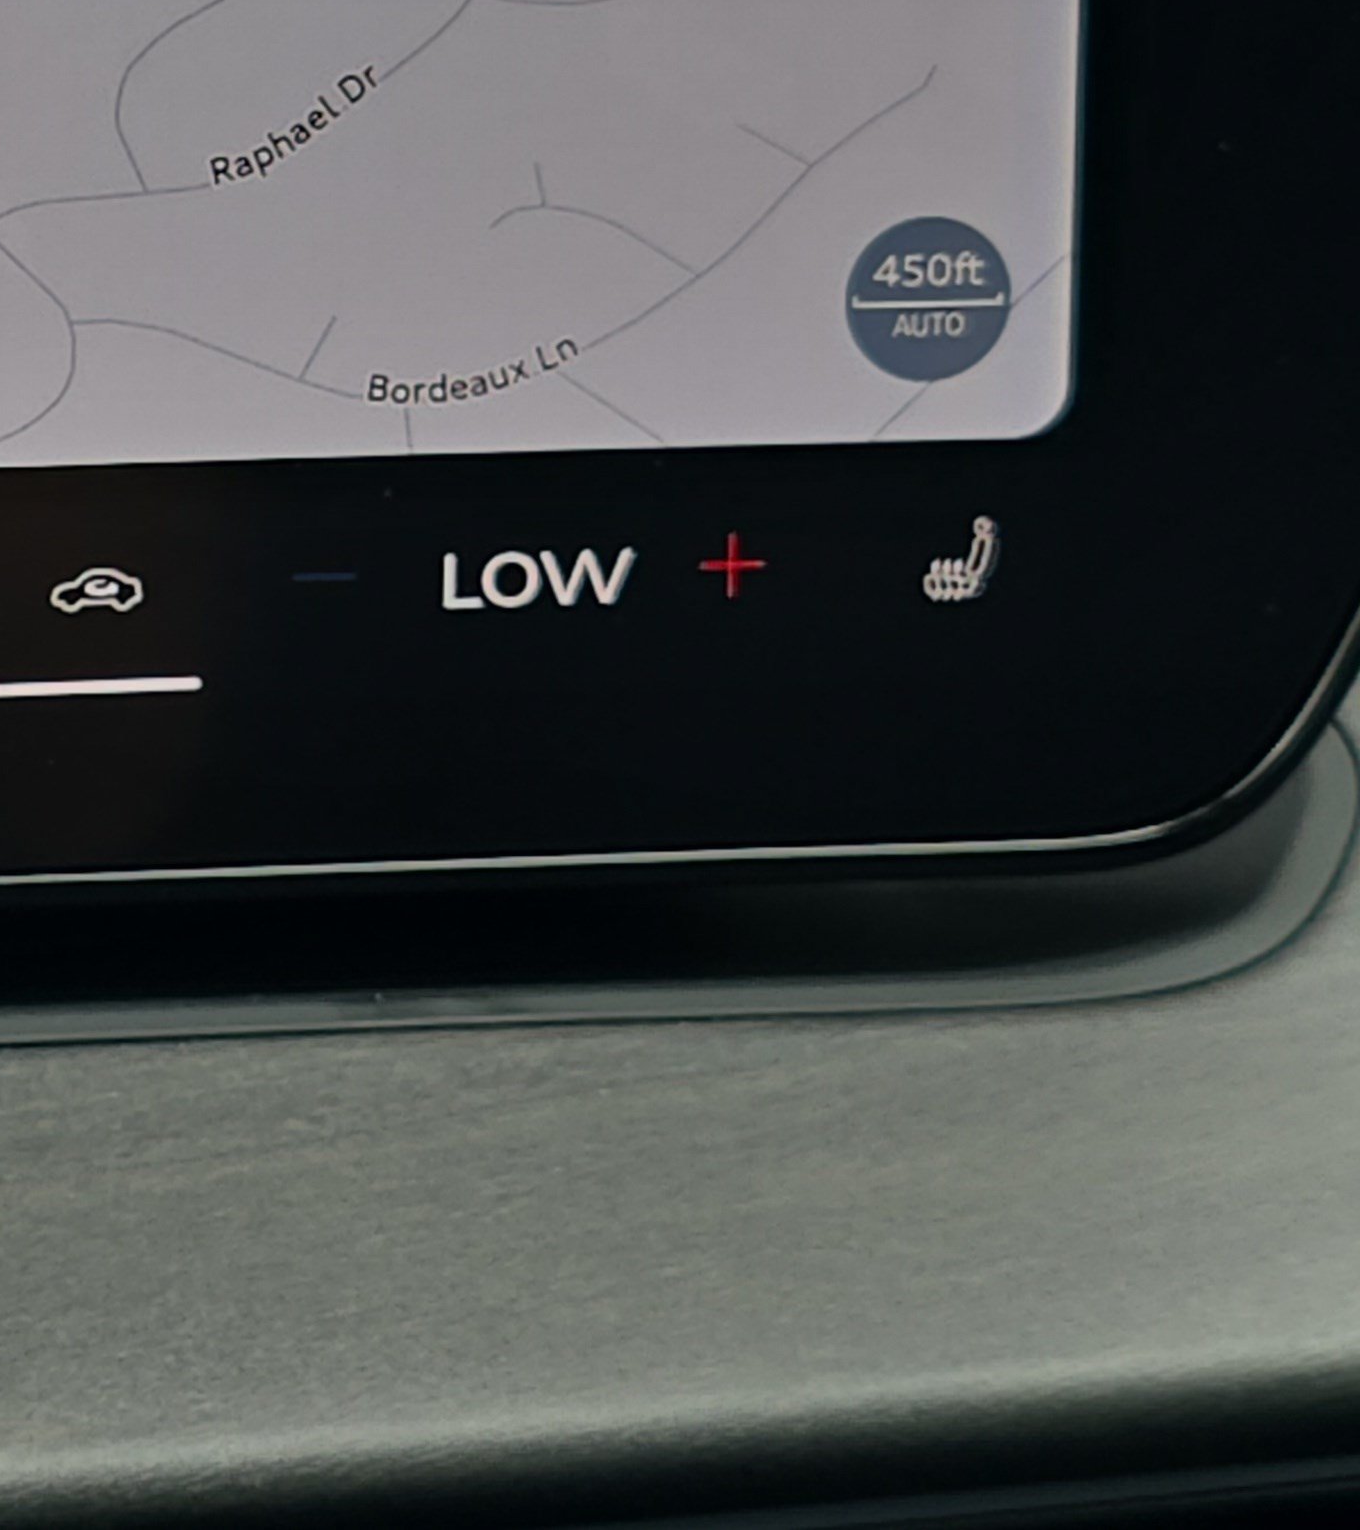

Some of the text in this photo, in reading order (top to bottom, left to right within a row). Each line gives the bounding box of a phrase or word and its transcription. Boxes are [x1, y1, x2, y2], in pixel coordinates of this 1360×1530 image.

[209, 64, 377, 186] Raphael Dr
[872, 250, 985, 288] 450ft
[891, 312, 965, 338] AUTO
[367, 338, 579, 404] Bordeaux Ln
[441, 546, 637, 610] LOW
